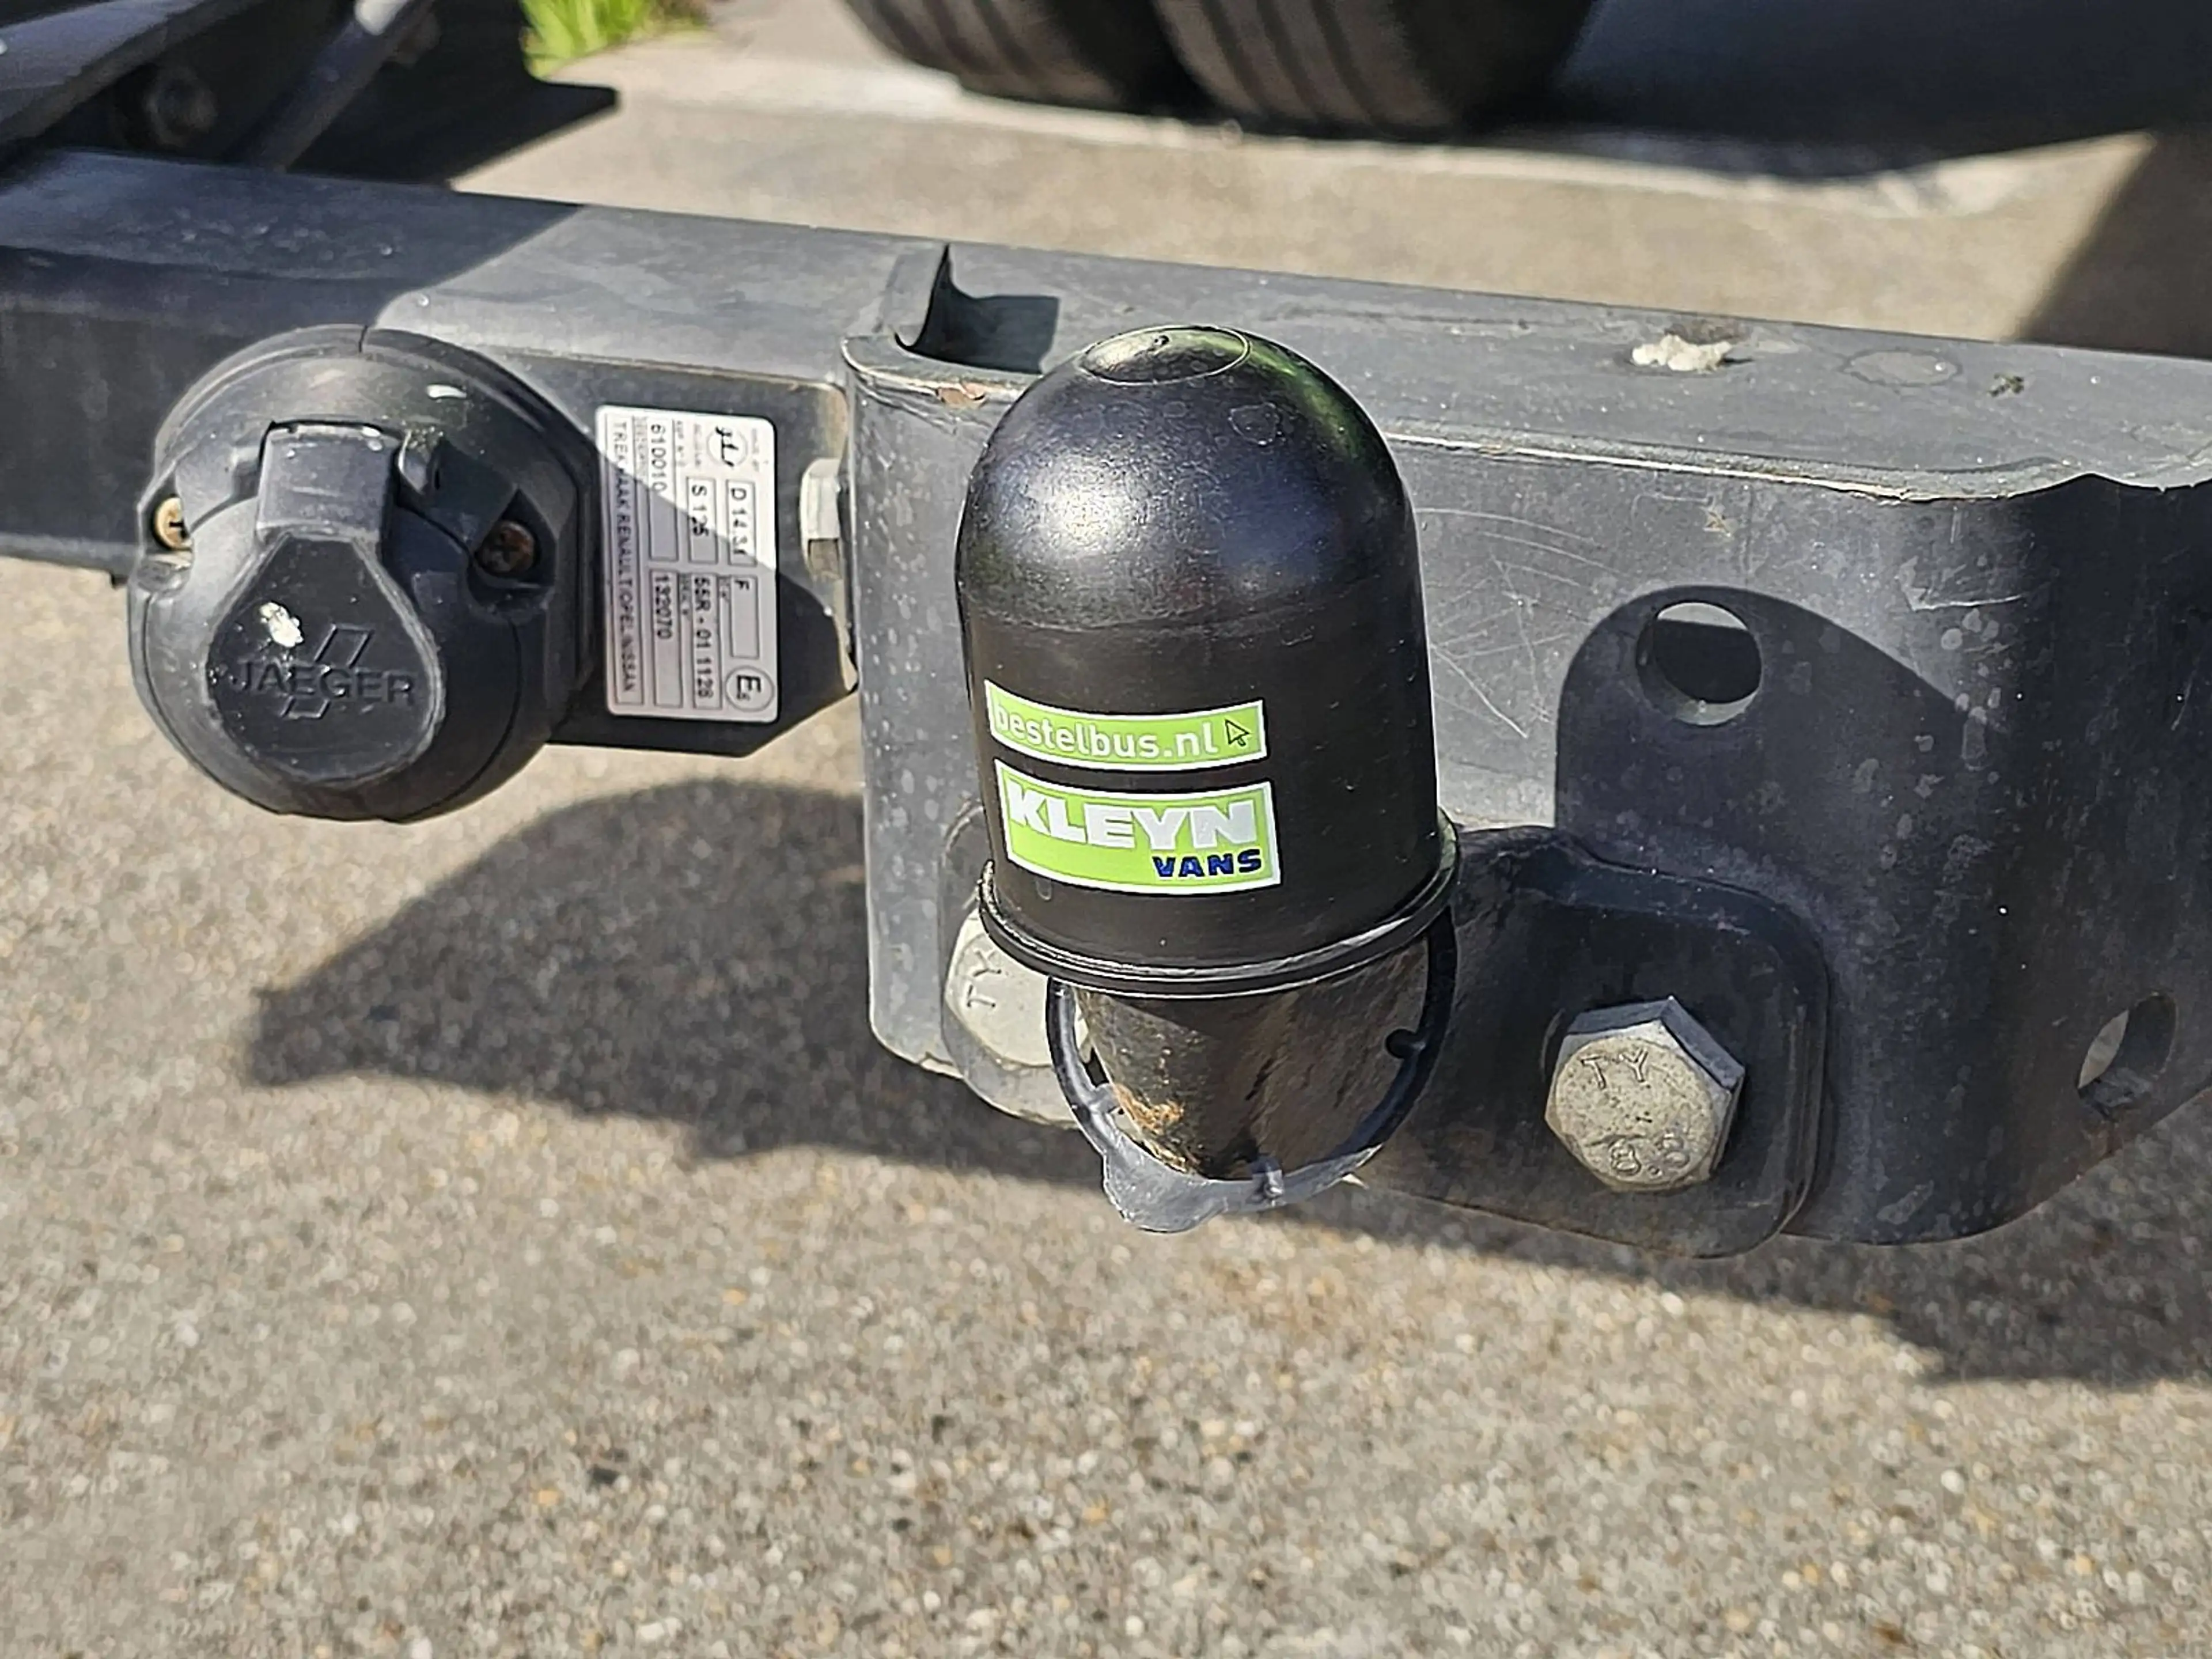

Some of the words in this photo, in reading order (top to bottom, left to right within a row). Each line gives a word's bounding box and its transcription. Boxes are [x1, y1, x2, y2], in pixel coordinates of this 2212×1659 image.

[650, 423, 667, 491] 610010
[692, 484, 707, 497] S
[731, 487, 747, 501] D
[692, 506, 709, 537] 125
[695, 577, 710, 612] 55R
[735, 579, 750, 590] F
[696, 629, 711, 649] 01
[232, 658, 415, 706] JAEGER
[994, 700, 1219, 759] bestelbus.nl
[1007, 778, 1257, 850] KLEYN
[1152, 848, 1263, 878] VANS
